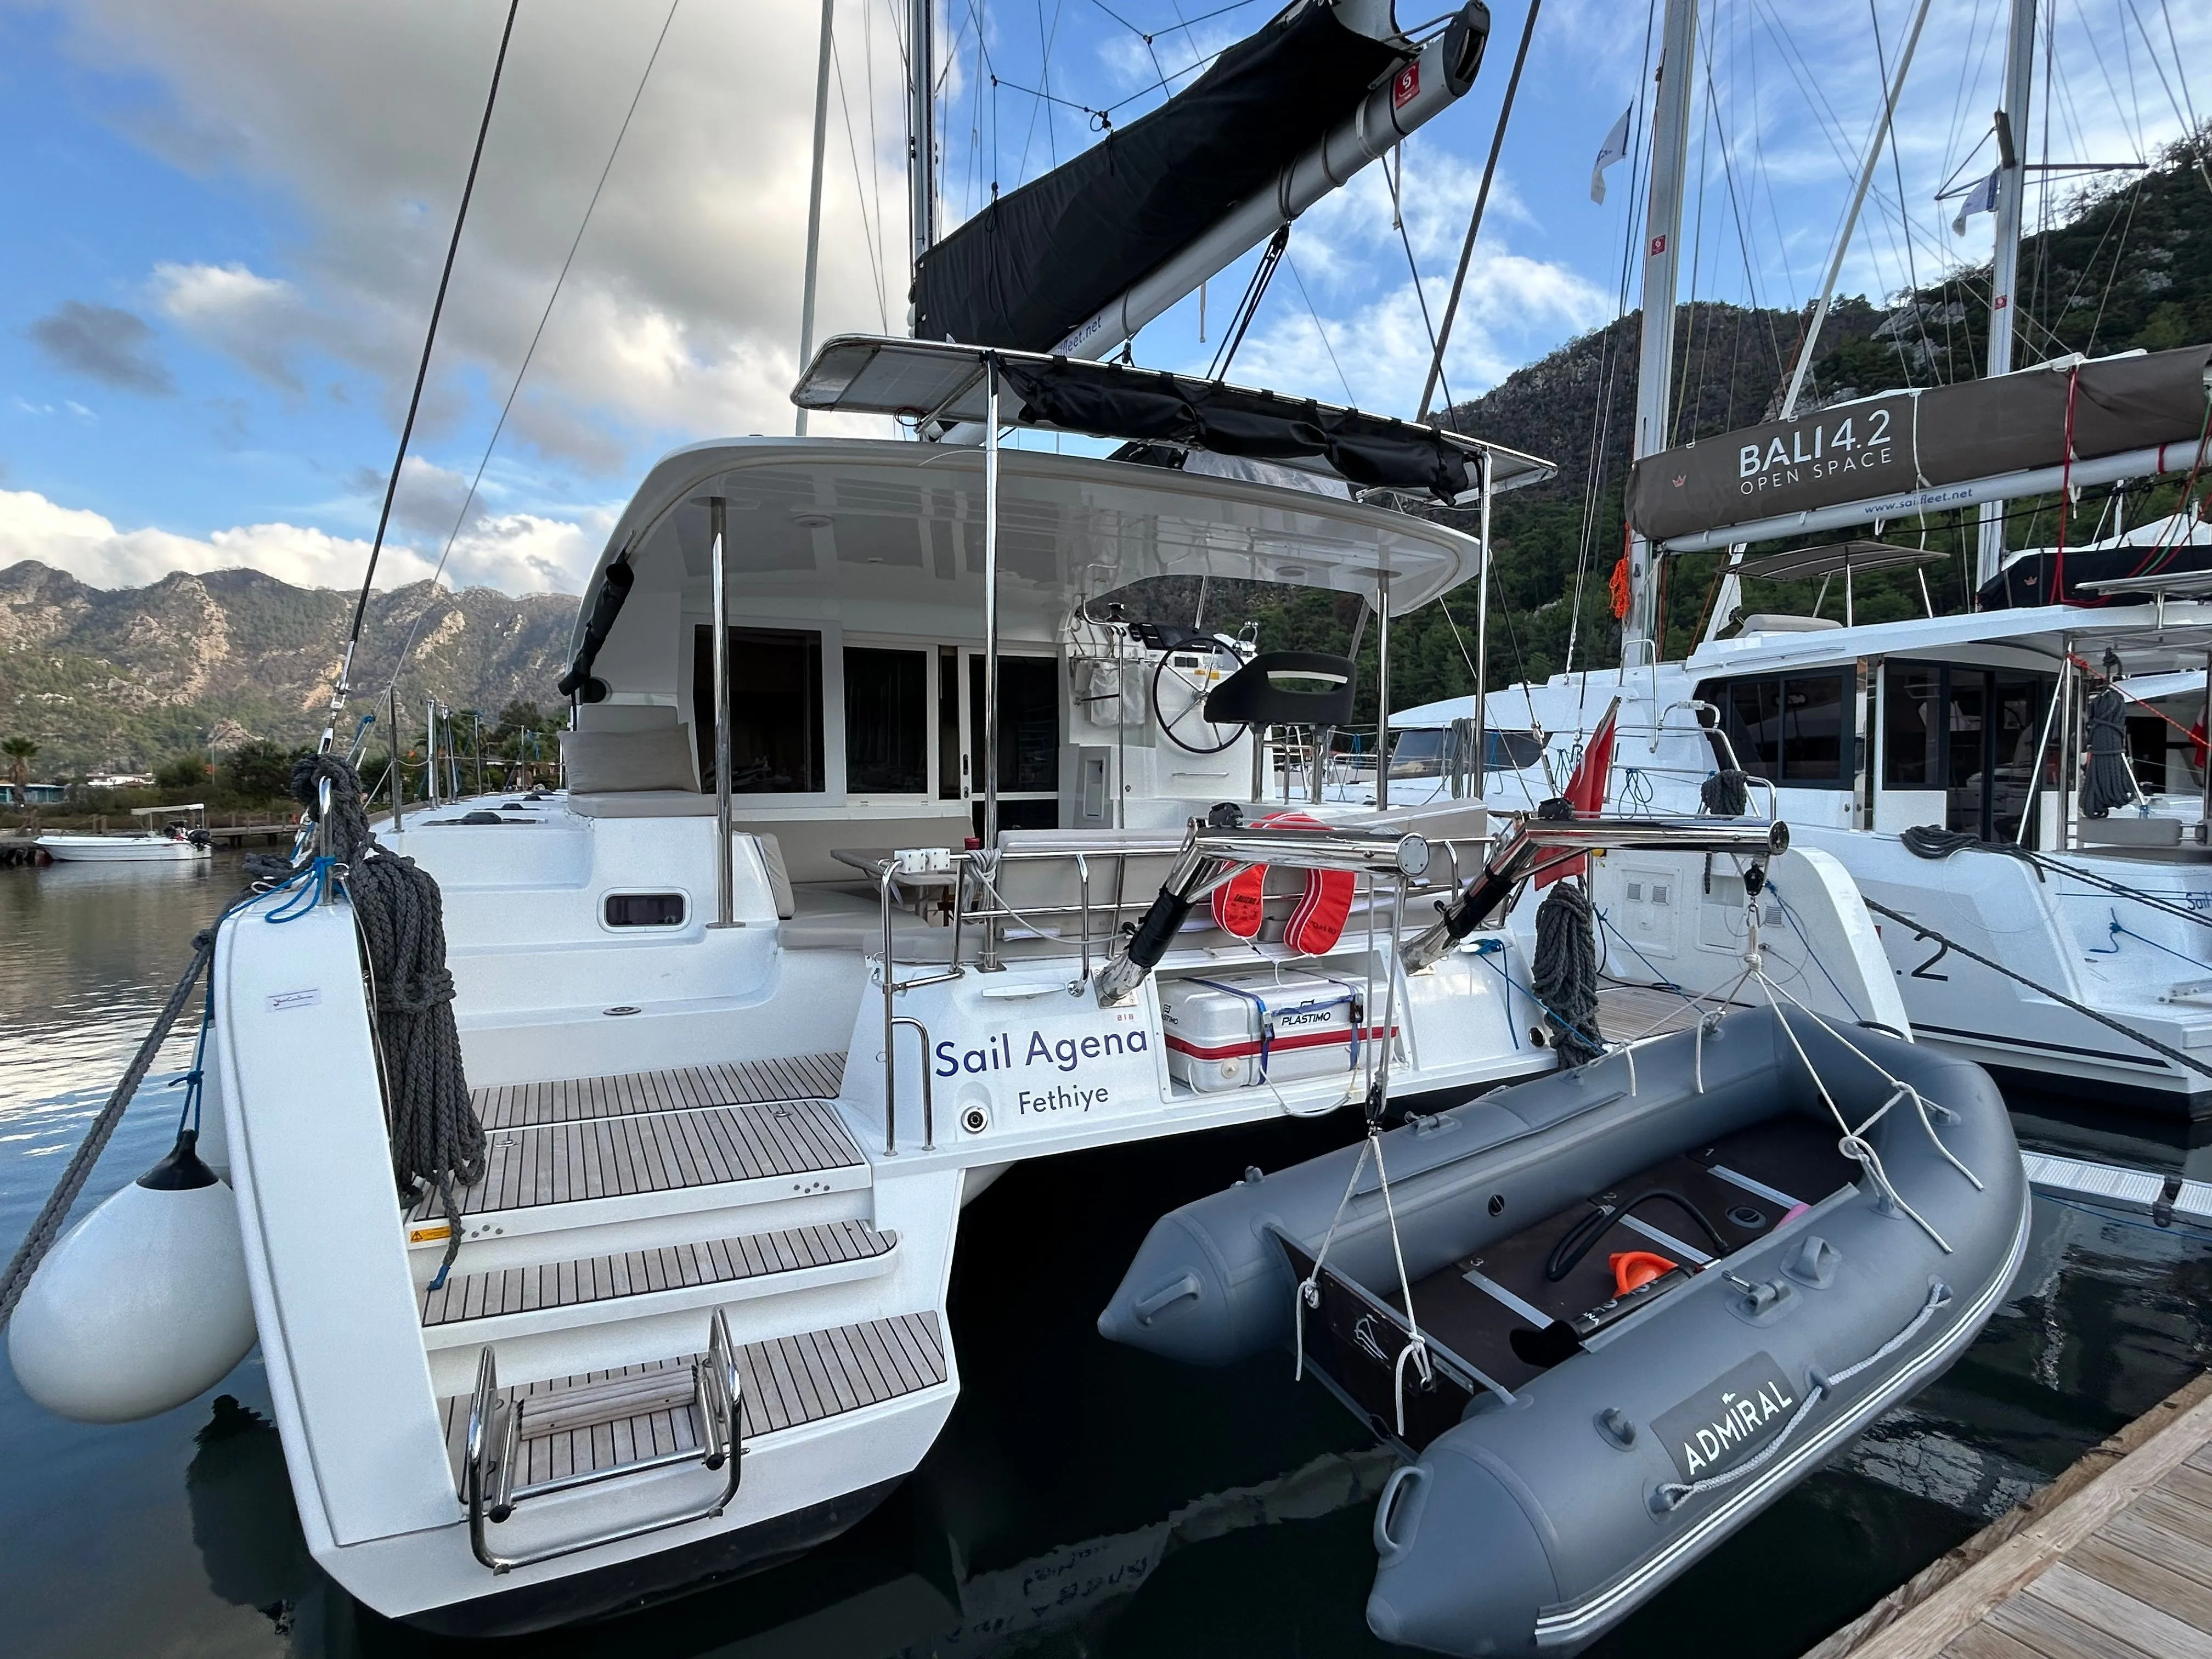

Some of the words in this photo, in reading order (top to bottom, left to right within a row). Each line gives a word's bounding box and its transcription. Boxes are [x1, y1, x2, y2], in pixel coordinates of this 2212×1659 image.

[1740, 426, 1822, 477] BALI
[1831, 409, 1891, 451] 4.2
[1740, 469, 1799, 494] OPEN
[1813, 448, 1892, 478] SPACE
[1865, 488, 1973, 513] www.saifleet.net
[1282, 1012, 1331, 1026] PLASTIMO
[935, 1032, 1011, 1077] Sail
[1025, 1030, 1148, 1071] Agena
[1018, 1085, 1109, 1115] Fethiye
[1470, 1257, 1484, 1266] 3
[1684, 1380, 1793, 1476] ADMIRAL
